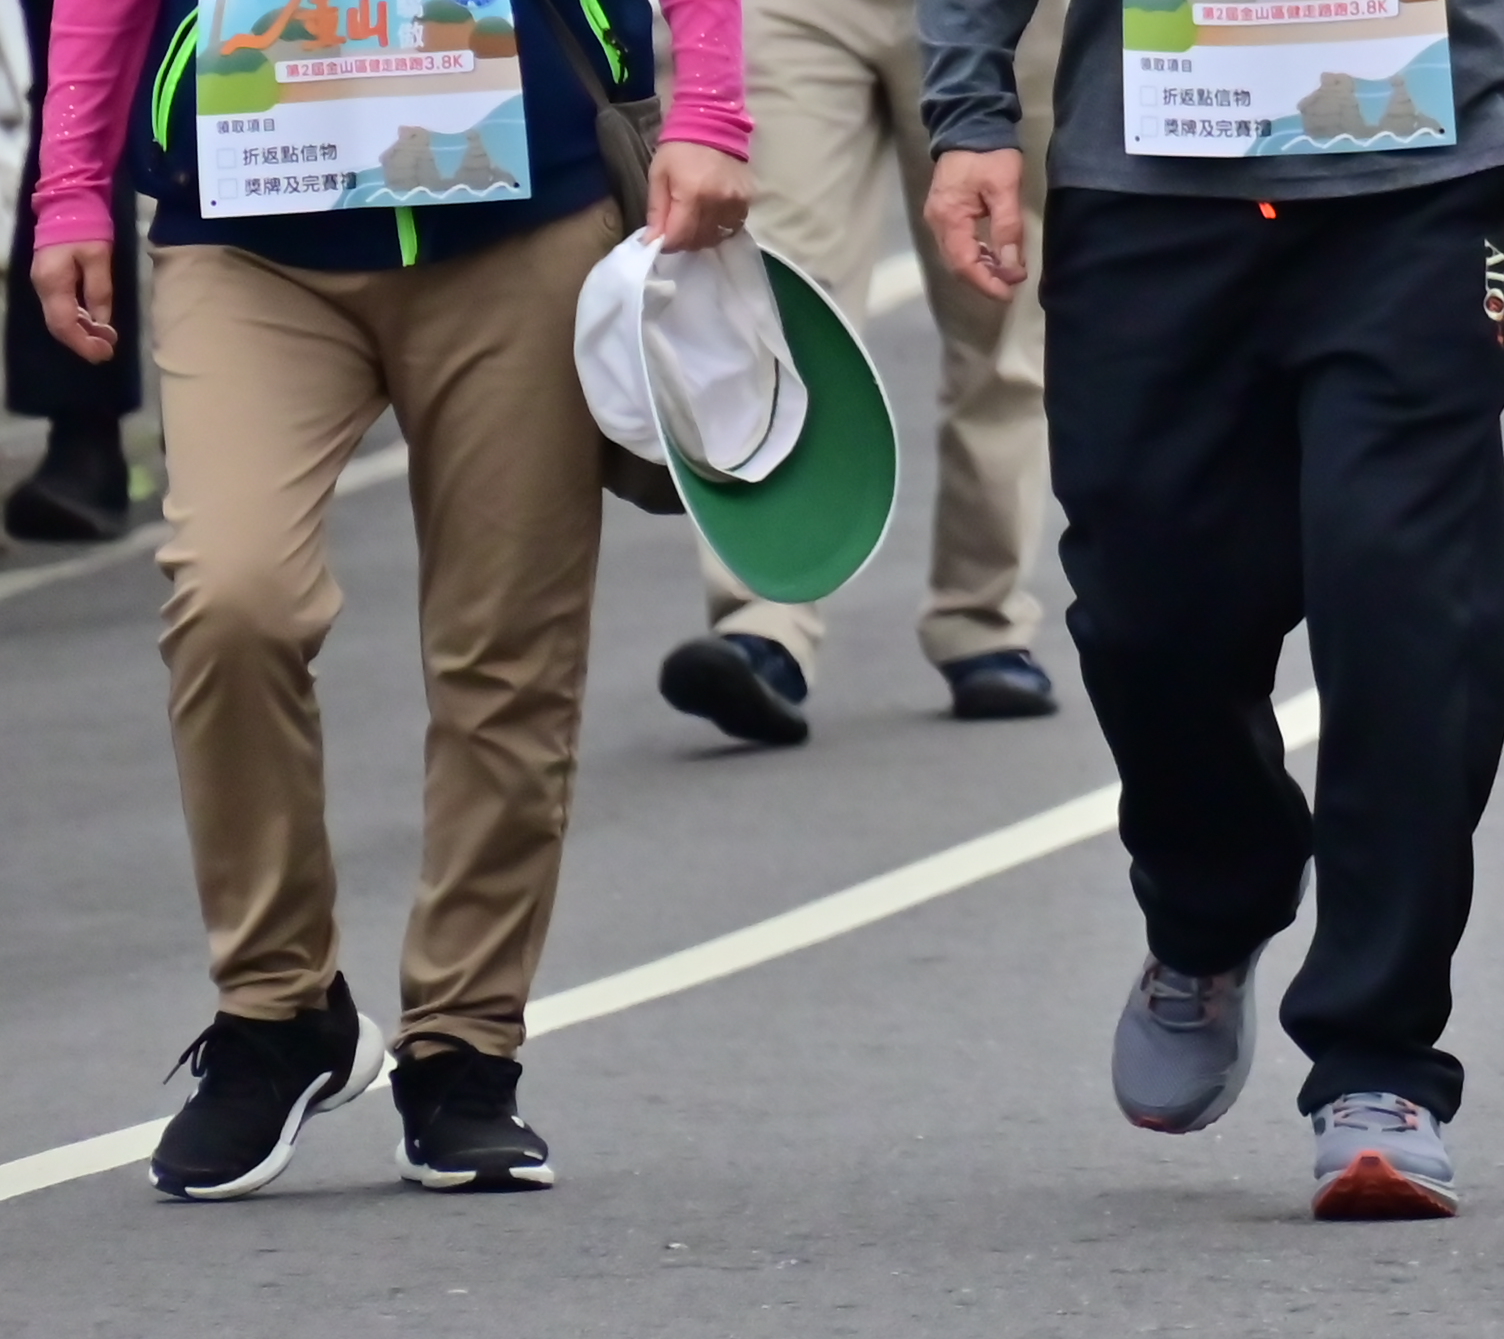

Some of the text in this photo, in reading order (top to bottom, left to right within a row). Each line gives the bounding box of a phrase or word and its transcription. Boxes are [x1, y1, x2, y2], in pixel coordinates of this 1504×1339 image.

[1162, 87, 1252, 107] 折返點信物
[217, 118, 275, 134] 領取項目
[1164, 119, 1272, 138] 獎牌及完賽禮
[242, 143, 338, 167] 折返點信物
[244, 171, 357, 197] 獎牌及完賽禮
